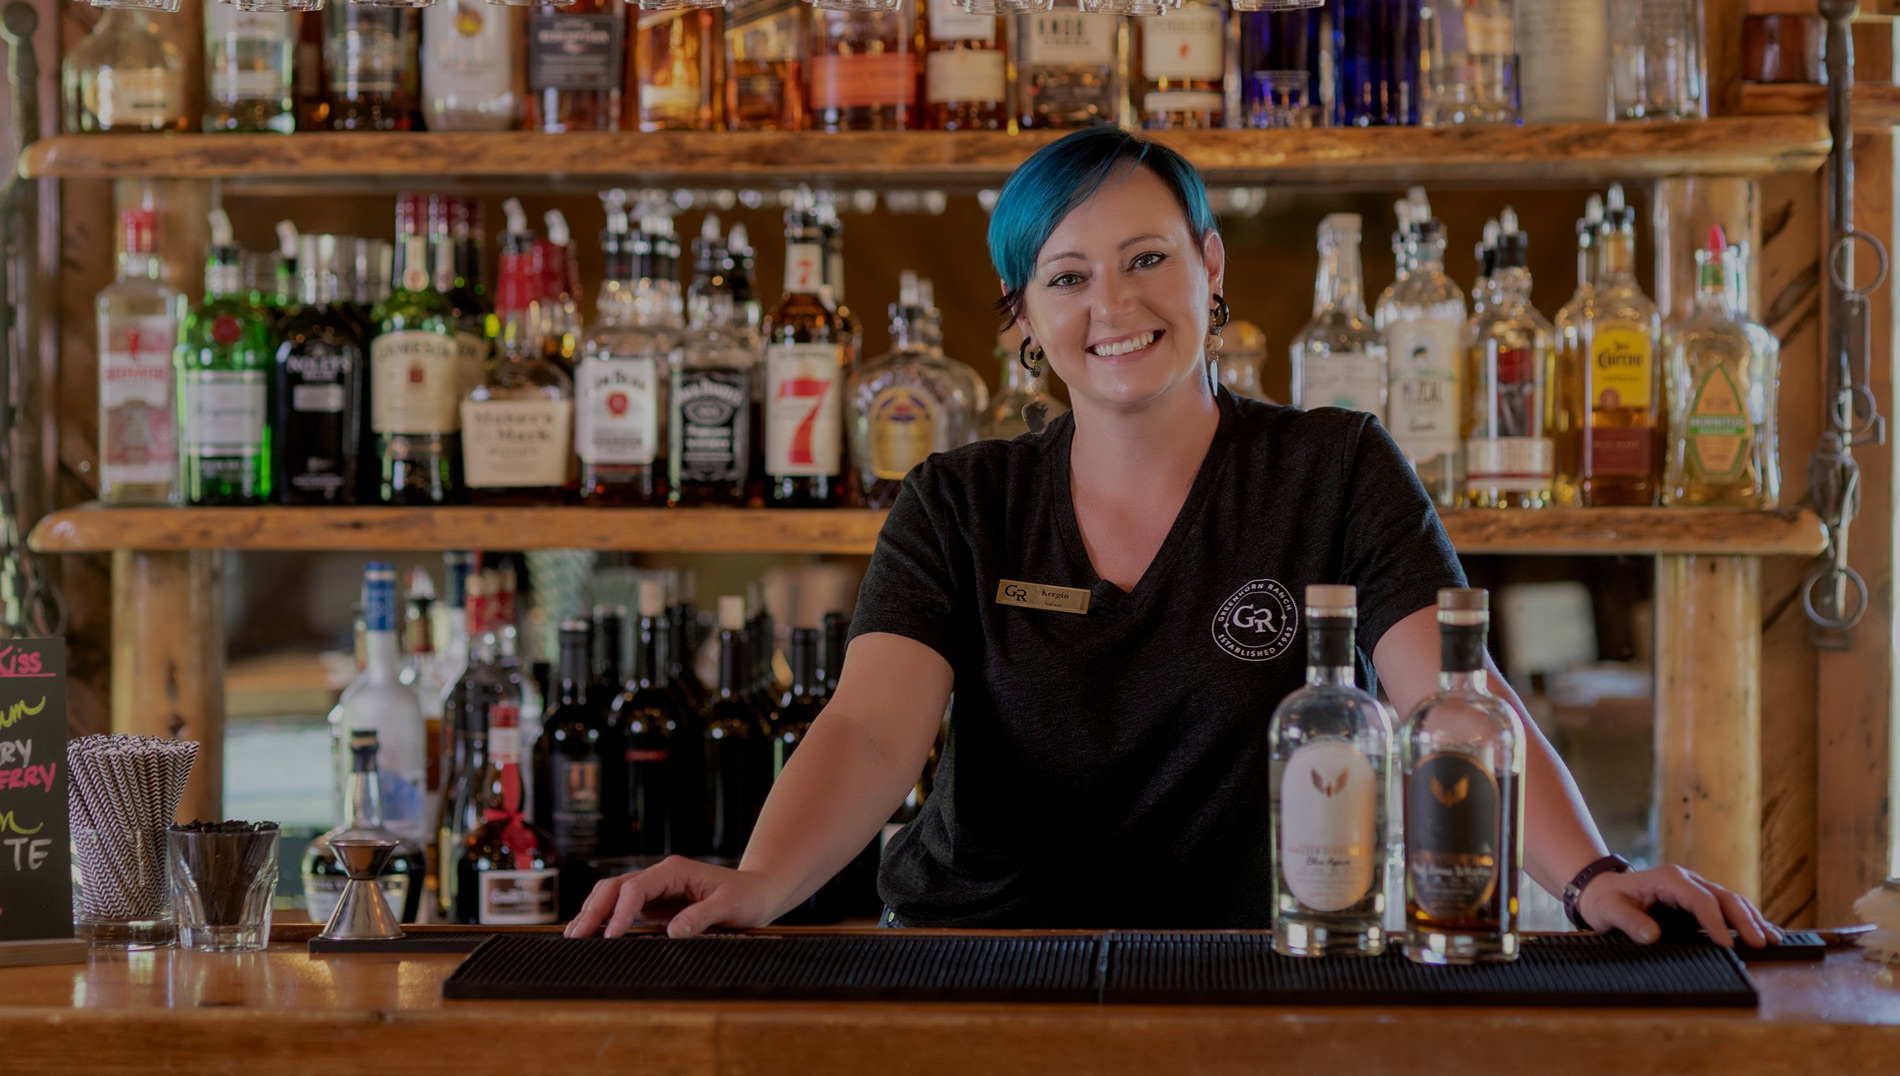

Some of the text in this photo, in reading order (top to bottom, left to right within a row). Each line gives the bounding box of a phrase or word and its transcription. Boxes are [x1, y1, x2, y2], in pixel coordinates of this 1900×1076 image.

[776, 377, 831, 464] 7
[1005, 584, 1028, 602] GR
[1218, 583, 1293, 622] GREENHORN RANCH
[1232, 604, 1278, 633] GR
[1217, 626, 1294, 657] ESTABLISHED 1962
